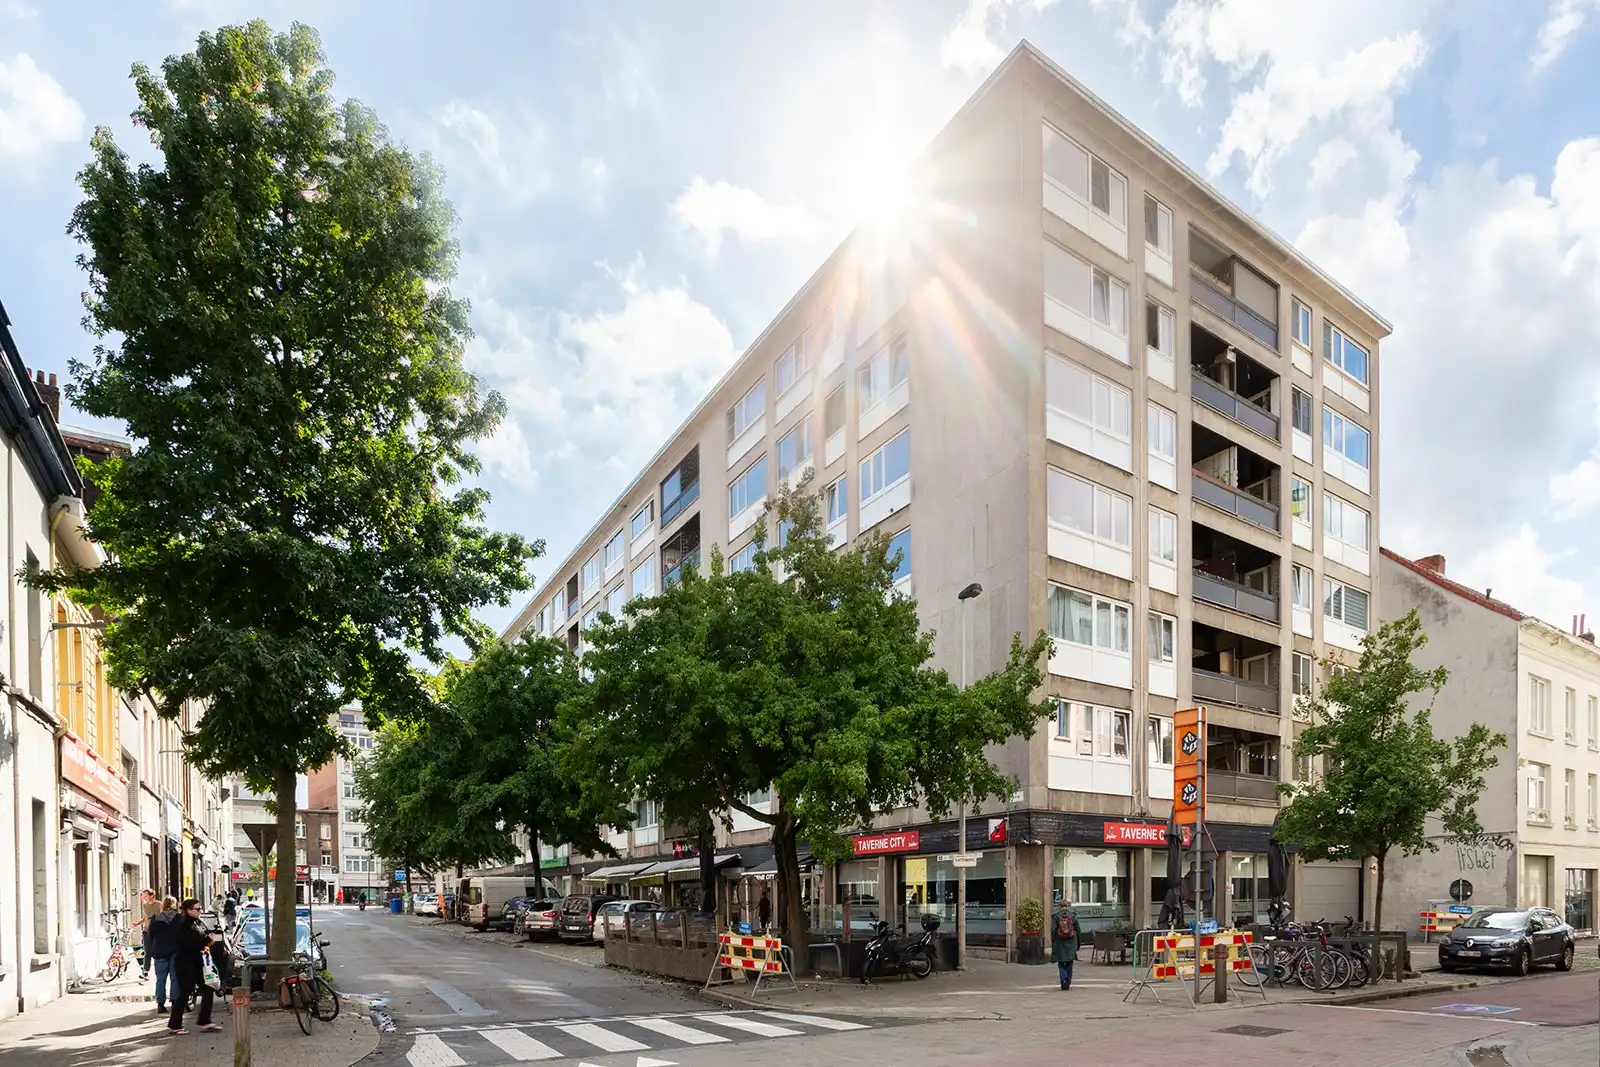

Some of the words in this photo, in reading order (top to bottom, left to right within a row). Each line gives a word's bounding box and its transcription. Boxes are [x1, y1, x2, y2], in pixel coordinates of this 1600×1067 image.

[1120, 827, 1158, 840] TAVERNE
[858, 837, 889, 851] TAVERNE
[889, 836, 906, 849] CITY
